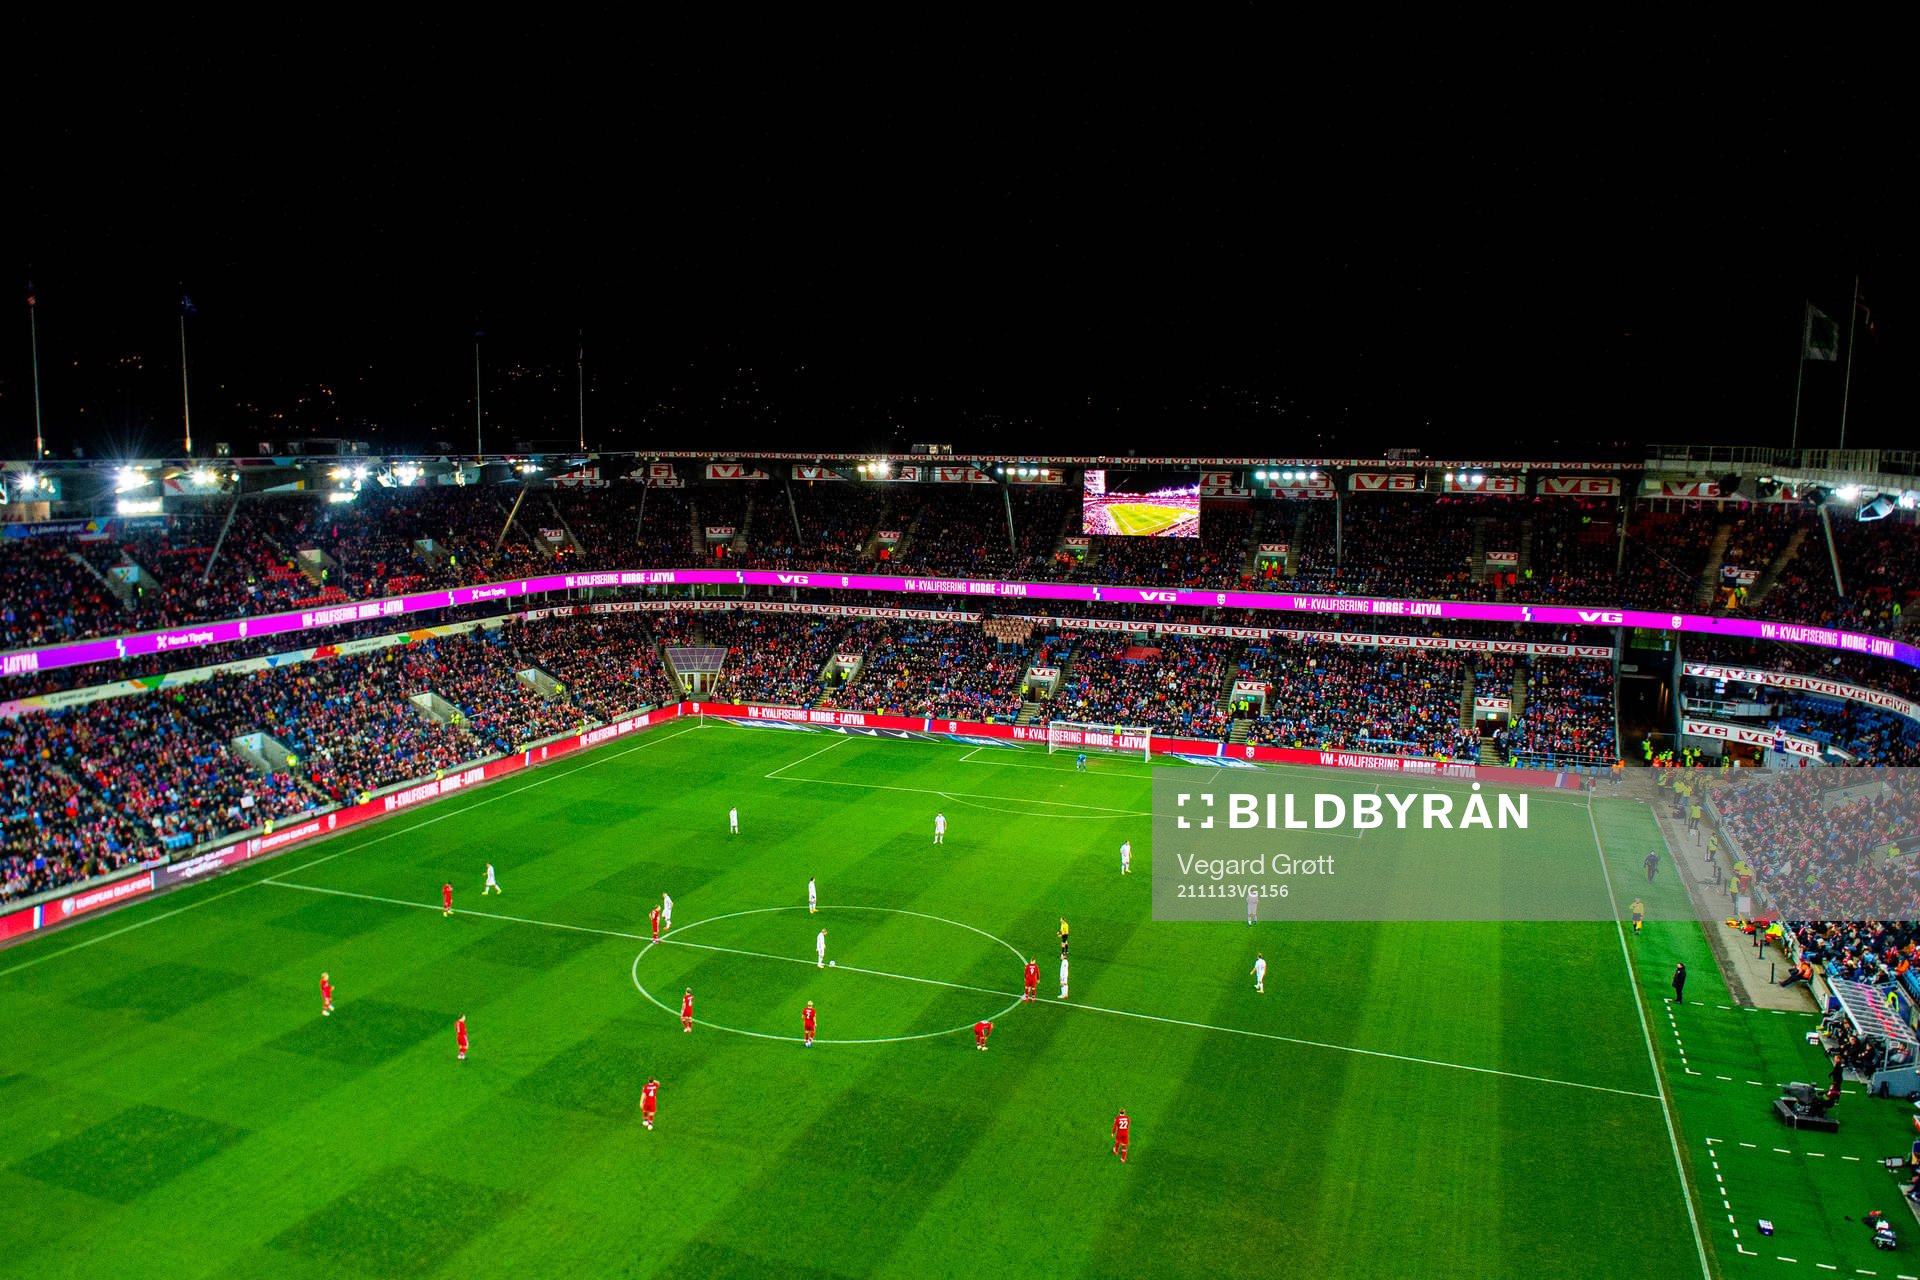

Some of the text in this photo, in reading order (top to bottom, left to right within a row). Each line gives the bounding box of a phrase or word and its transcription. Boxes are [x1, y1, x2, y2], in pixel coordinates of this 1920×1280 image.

[1358, 475, 1415, 489] VG
[1453, 477, 1514, 492] VG
[1549, 478, 1610, 493] VG
[1667, 481, 1721, 496] VG
[565, 573, 618, 587] VM-KVALIFISERING
[777, 574, 808, 584] VG
[904, 579, 966, 592] VM-KVALIFISERING
[1139, 591, 1176, 601] VG
[1294, 598, 1368, 612] VM-KVALIFISERING
[1578, 611, 1622, 623] VG
[168, 632, 214, 647] Norsk Tipping
[1062, 619, 1089, 627] VG
[1095, 621, 1122, 629] VG
[1128, 622, 1156, 630] VG
[1232, 629, 1261, 637] VG
[1378, 636, 1409, 644] VG
[1416, 638, 1448, 647] VG
[1456, 640, 1487, 649] VG
[1495, 643, 1527, 651] VG
[1534, 645, 1567, 654] VG
[1576, 647, 1608, 656] VG
[1761, 624, 1837, 646] VM-KVALIFISERING
[837, 655, 860, 663] VG
[1033, 667, 1058, 676] VG
[1238, 681, 1266, 690] VG
[1768, 675, 1802, 688] VG
[1806, 680, 1836, 694] VG
[1840, 686, 1866, 700] VG
[1870, 693, 1892, 706] VG
[1894, 700, 1910, 714] VG
[1477, 698, 1509, 708] VG
[748, 706, 808, 721] VM-KVALIFISERING
[1689, 724, 1814, 755] VG VG VG
[1320, 753, 1399, 771] VM-KVALIFISERING
[384, 781, 439, 812] VM-KVALIFISERING
[76, 877, 151, 909] EUROPEAN QUALIFIERS
